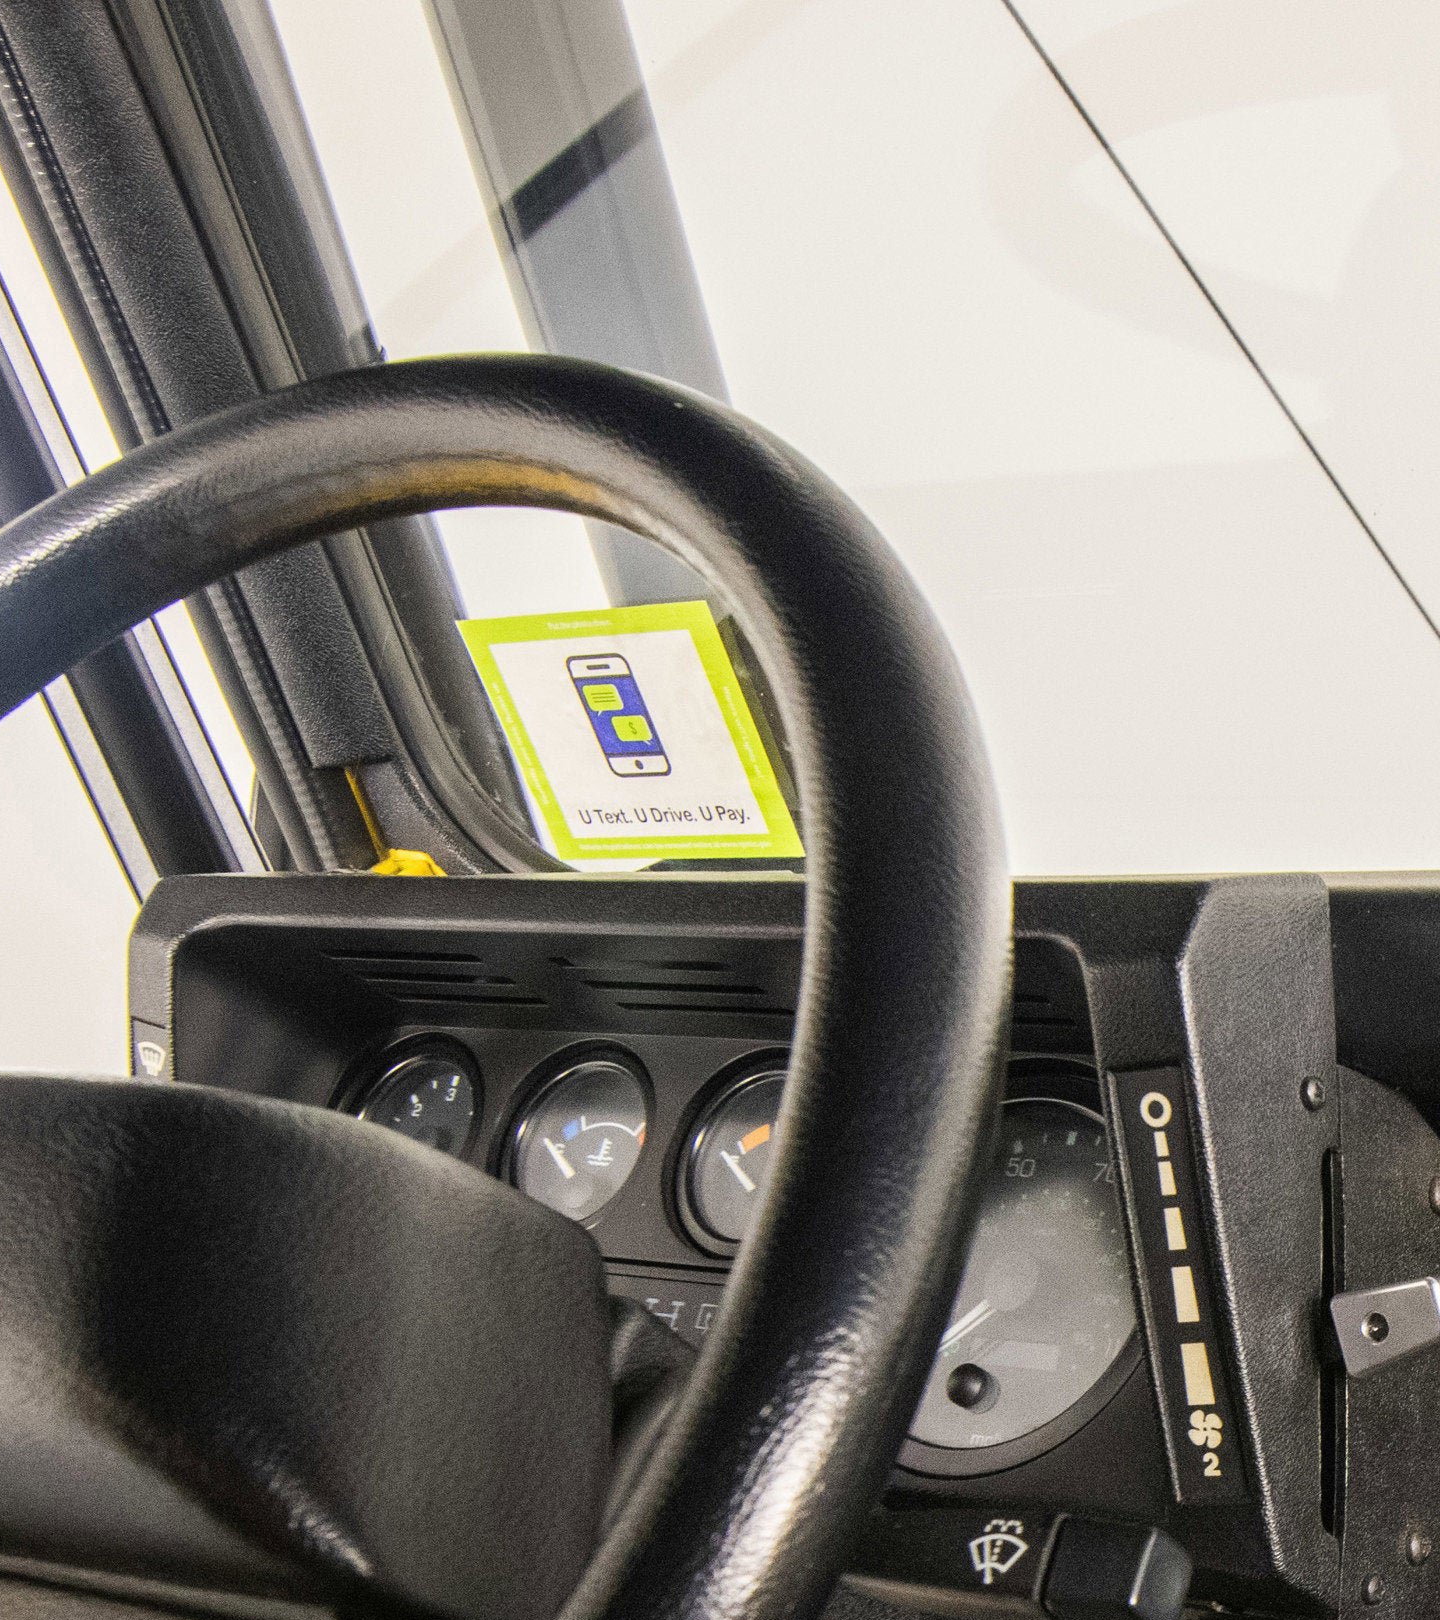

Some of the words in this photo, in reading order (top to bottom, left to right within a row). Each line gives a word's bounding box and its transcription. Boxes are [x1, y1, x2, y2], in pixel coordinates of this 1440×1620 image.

[579, 808, 593, 825] U
[594, 808, 634, 825] Text.
[636, 807, 650, 824] U
[651, 805, 698, 823] Drive.
[699, 804, 714, 822] U
[716, 803, 751, 825] Pay.
[445, 1087, 457, 1102] 3
[410, 1103, 423, 1117] 2
[1005, 1157, 1036, 1178] 50
[1202, 1452, 1222, 1477] 2
